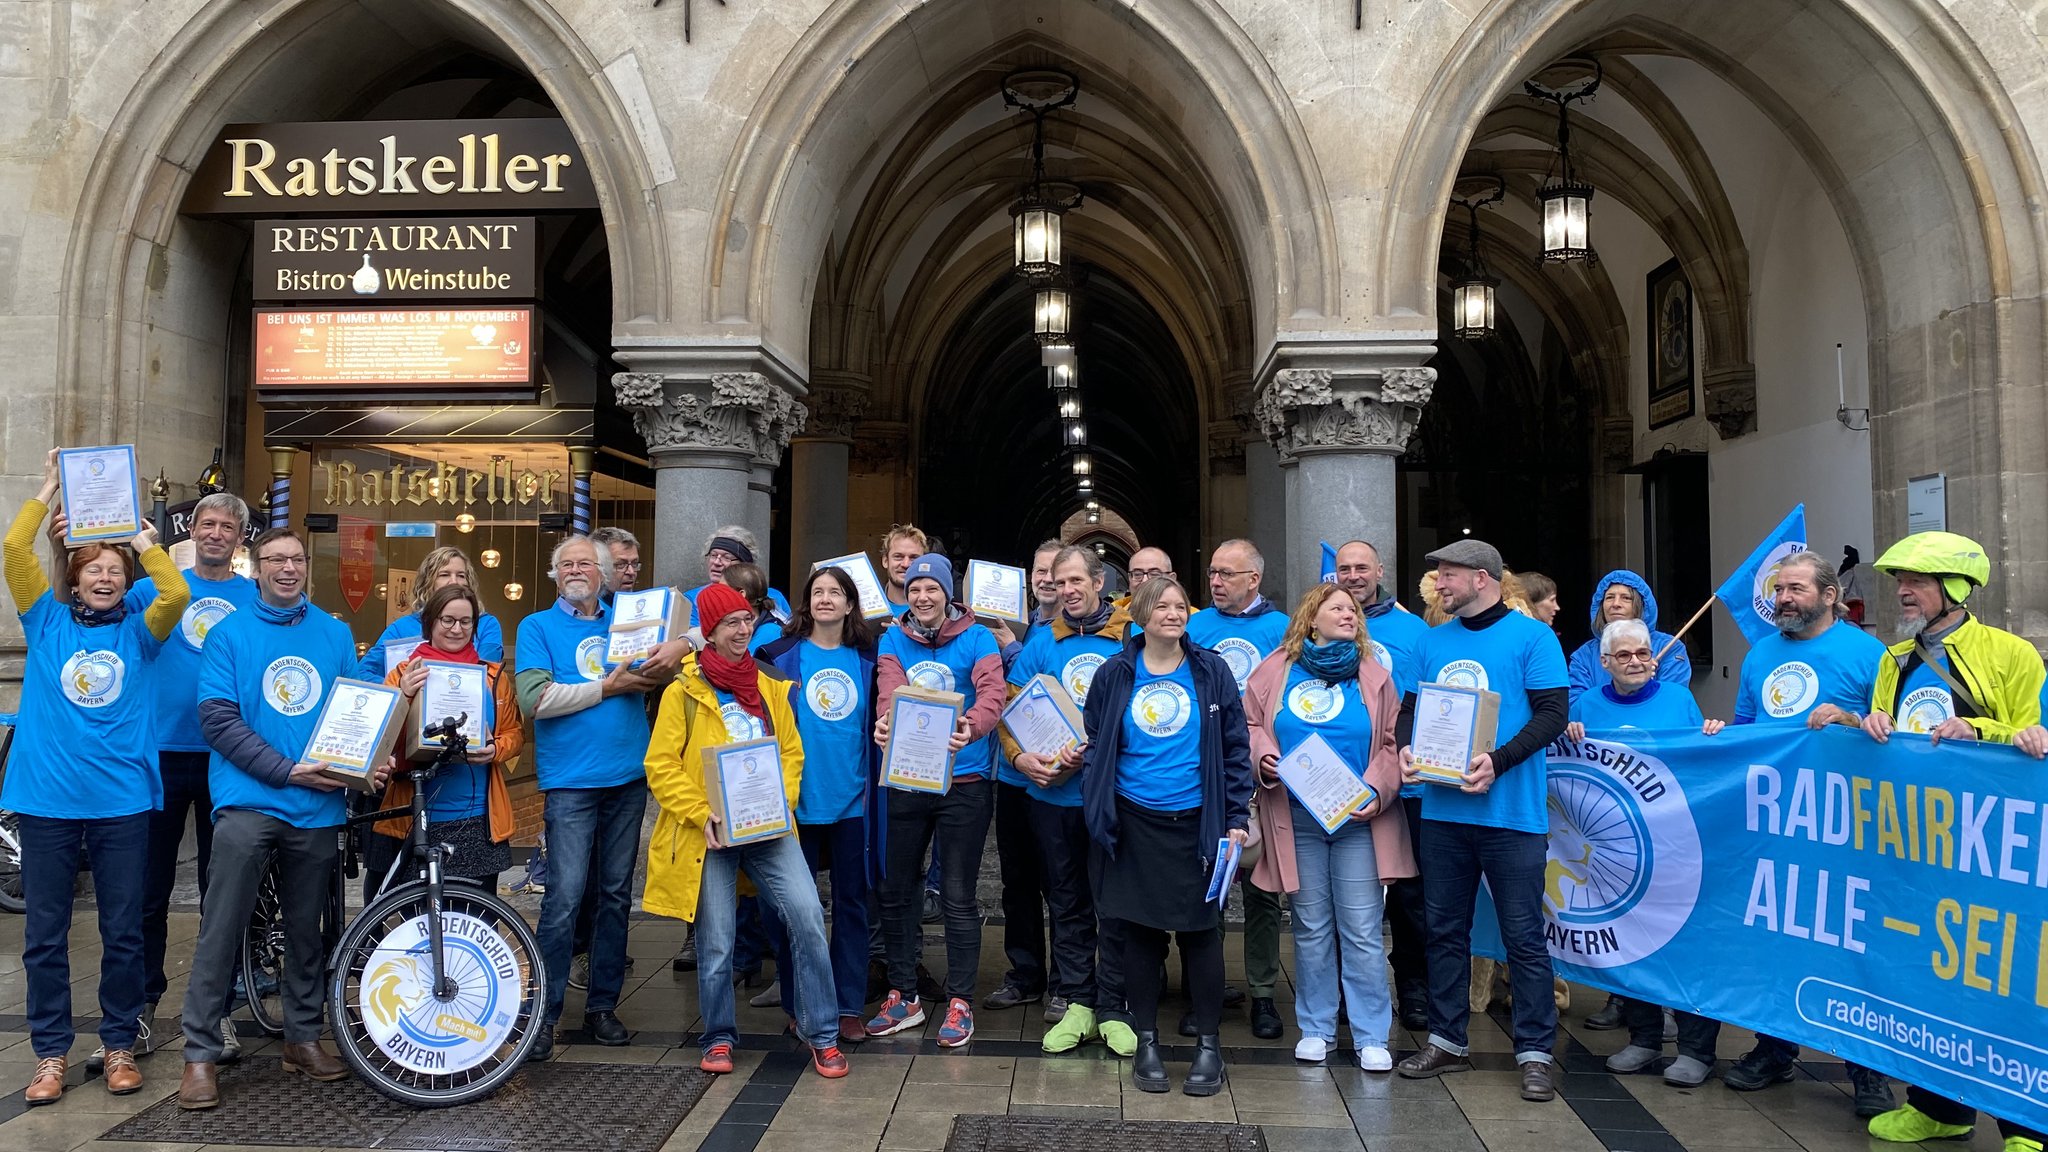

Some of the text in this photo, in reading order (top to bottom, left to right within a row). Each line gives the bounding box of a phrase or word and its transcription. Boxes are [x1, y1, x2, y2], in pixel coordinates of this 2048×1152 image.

[223, 133, 572, 197] Ratskeller
[271, 225, 517, 252] RESTAURANT
[276, 266, 511, 291] Bistro Weinstube
[267, 315, 284, 324] BEI
[288, 314, 311, 324] UNS
[316, 314, 332, 324] IST
[337, 313, 375, 324] IMMER
[379, 313, 405, 323] WAS
[410, 313, 432, 323] LOS
[436, 312, 450, 323] IM
[455, 312, 518, 323] NOVEMBER
[318, 459, 562, 506] Ratskeller
[270, 659, 313, 674] RADENTSCHEID
[813, 670, 851, 684] RADENTSCHEID
[912, 662, 948, 675] RADENTSCHEID
[1443, 662, 1482, 675] RADENTSCHEID
[1773, 664, 1812, 678] RADENTSCHEID
[77, 695, 105, 704] BAYERN
[1142, 682, 1184, 697] RADENTSCHEID
[1905, 689, 1949, 707] RADENTSCHEID
[1149, 726, 1172, 735] BAYERN
[1546, 735, 1667, 804] ENTSCHEID
[1745, 764, 2048, 889] RADFAIRKE
[1743, 857, 1871, 955] ALLE
[1931, 898, 2017, 997] SEI
[416, 917, 514, 980] RDENTSCHEID
[1547, 926, 1619, 955] AYERN
[440, 1016, 483, 1039] Mach mit!
[386, 1032, 446, 1069] BAYERN
[1826, 995, 2048, 1094] radentscheid-baye
